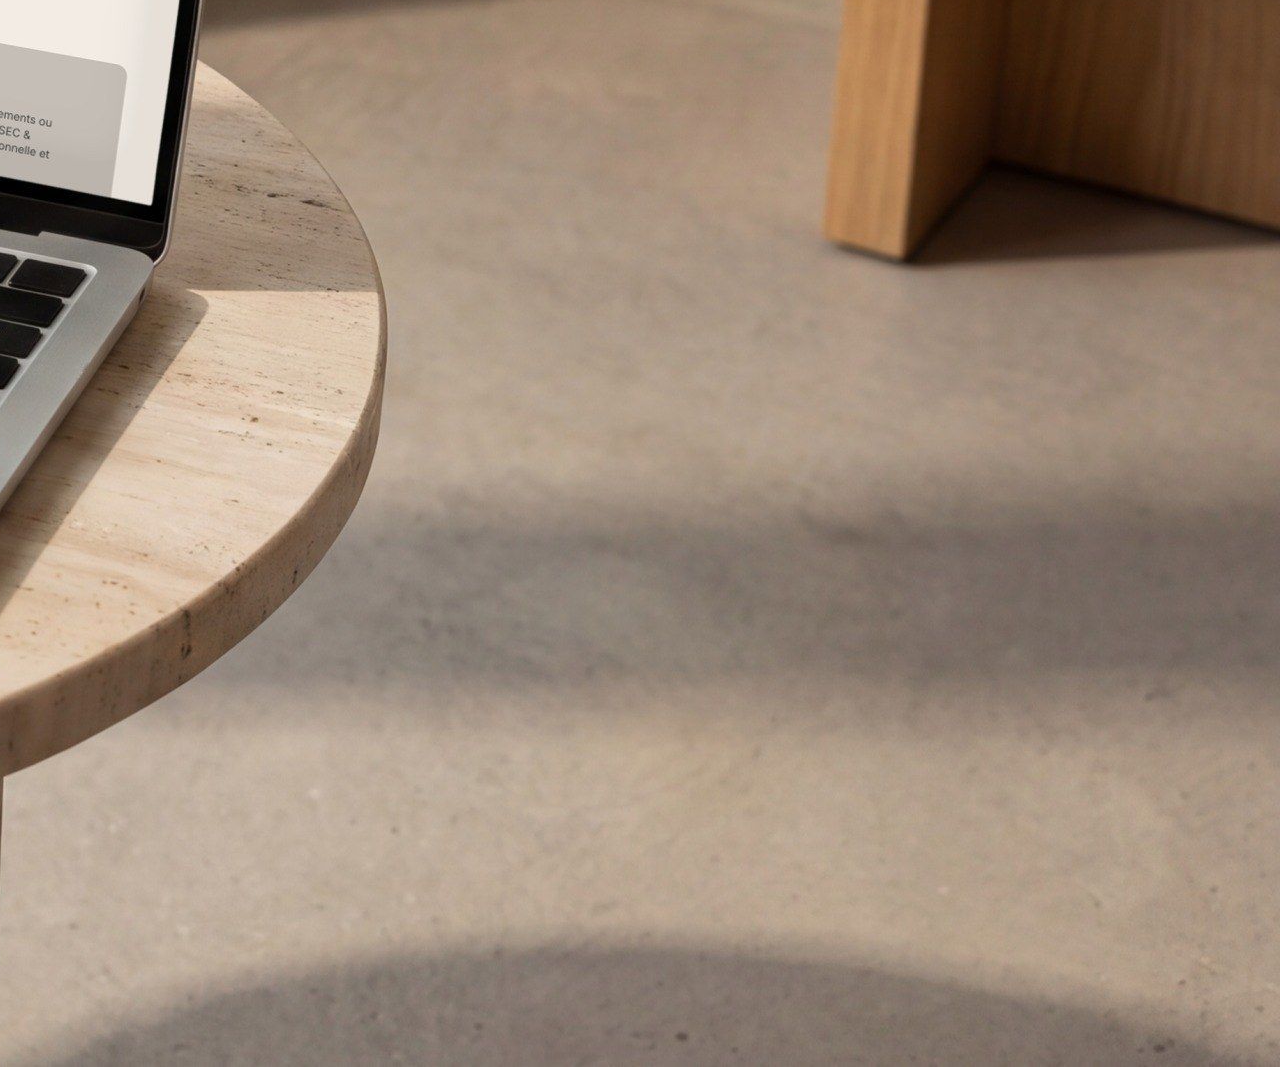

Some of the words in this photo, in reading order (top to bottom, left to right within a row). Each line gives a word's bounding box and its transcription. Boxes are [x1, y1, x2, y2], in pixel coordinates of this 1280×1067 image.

[38, 118, 53, 128] ou
[23, 129, 31, 140] &
[39, 150, 50, 160] et
